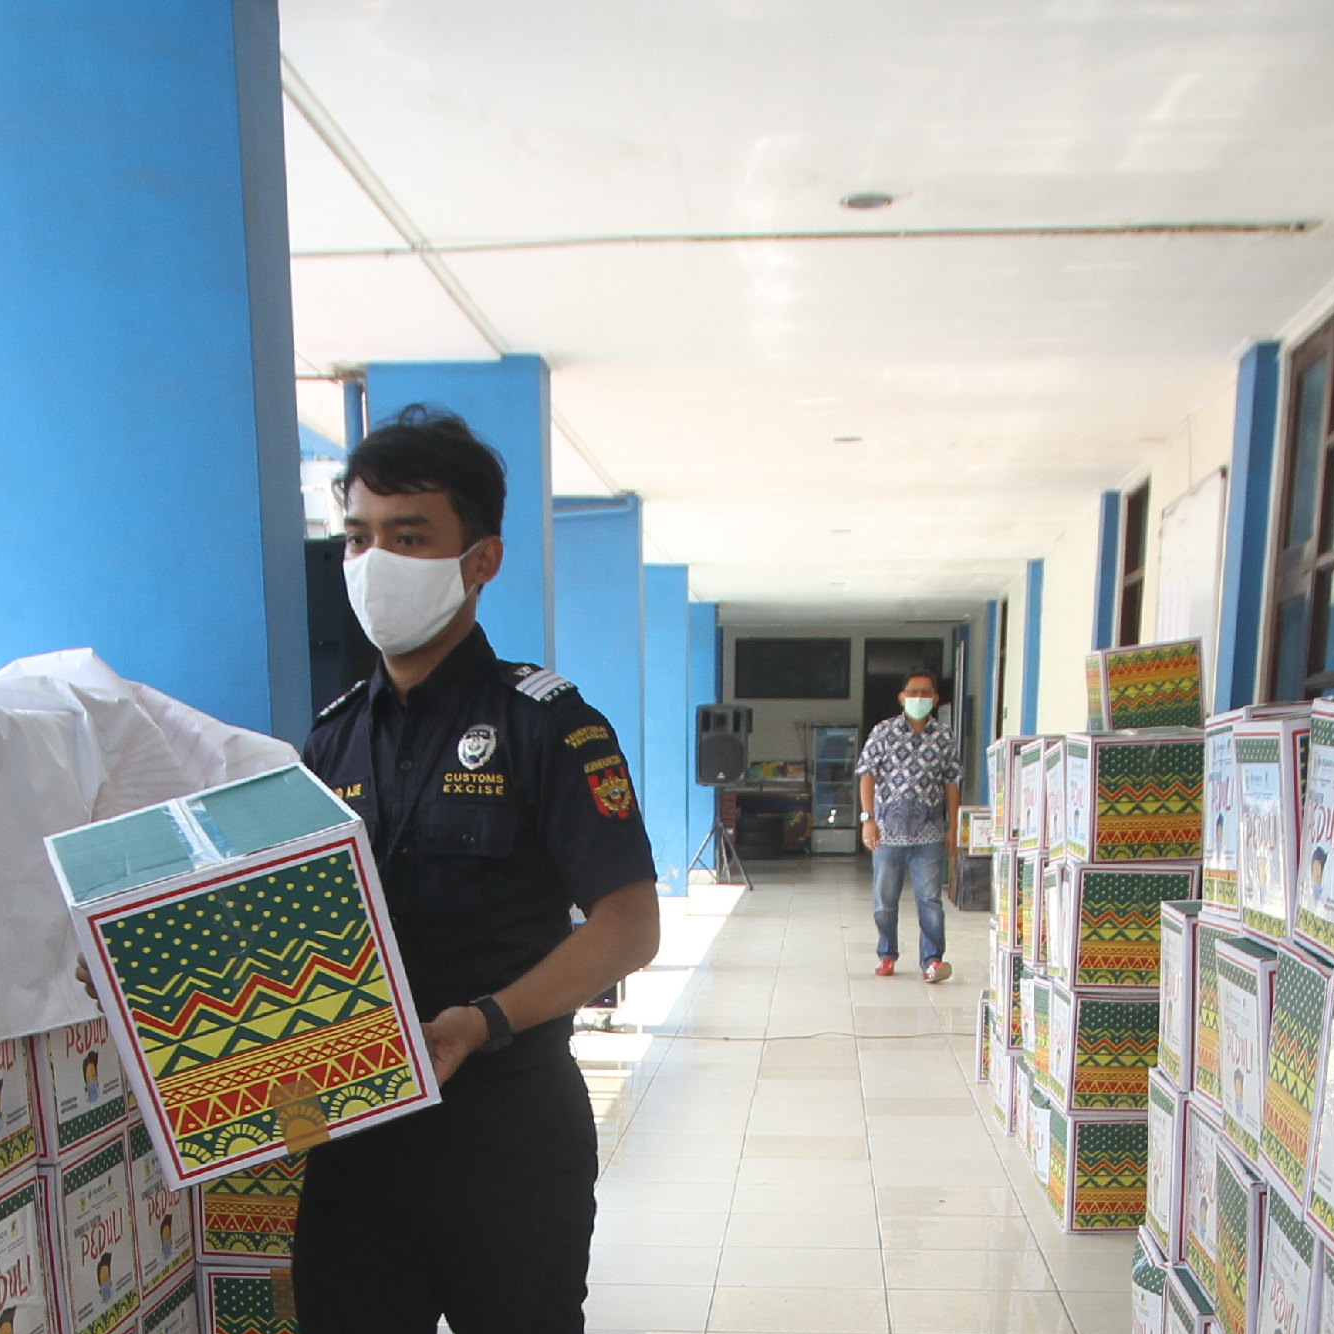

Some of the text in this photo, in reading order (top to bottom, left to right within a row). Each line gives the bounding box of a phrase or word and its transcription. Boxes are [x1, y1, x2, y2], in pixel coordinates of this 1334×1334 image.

[444, 772, 504, 784] CUSTOMS
[443, 784, 504, 795] EXCISE
[81, 1207, 124, 1267] PEDULI
